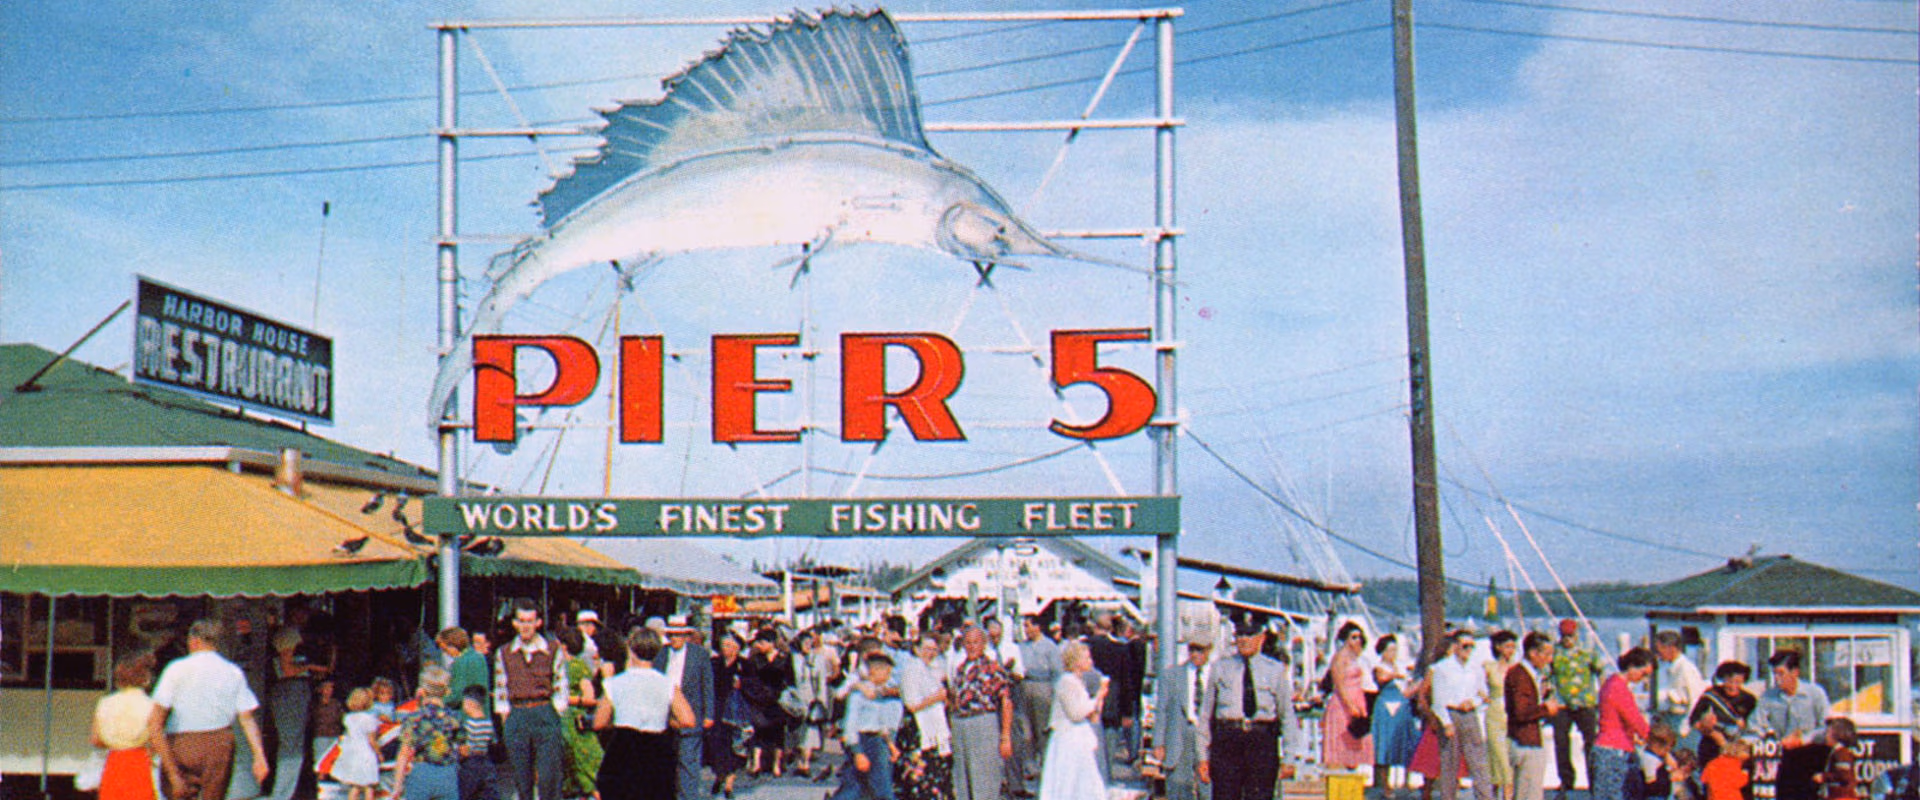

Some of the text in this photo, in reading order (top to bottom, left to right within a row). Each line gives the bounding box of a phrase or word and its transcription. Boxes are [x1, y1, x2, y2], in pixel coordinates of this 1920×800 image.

[163, 293, 310, 357] HARBOR HOUSE
[472, 328, 1158, 444] PIER 5
[659, 504, 790, 533] FINEST
[830, 504, 981, 532] FISHING
[1022, 503, 1140, 532] FLEET
